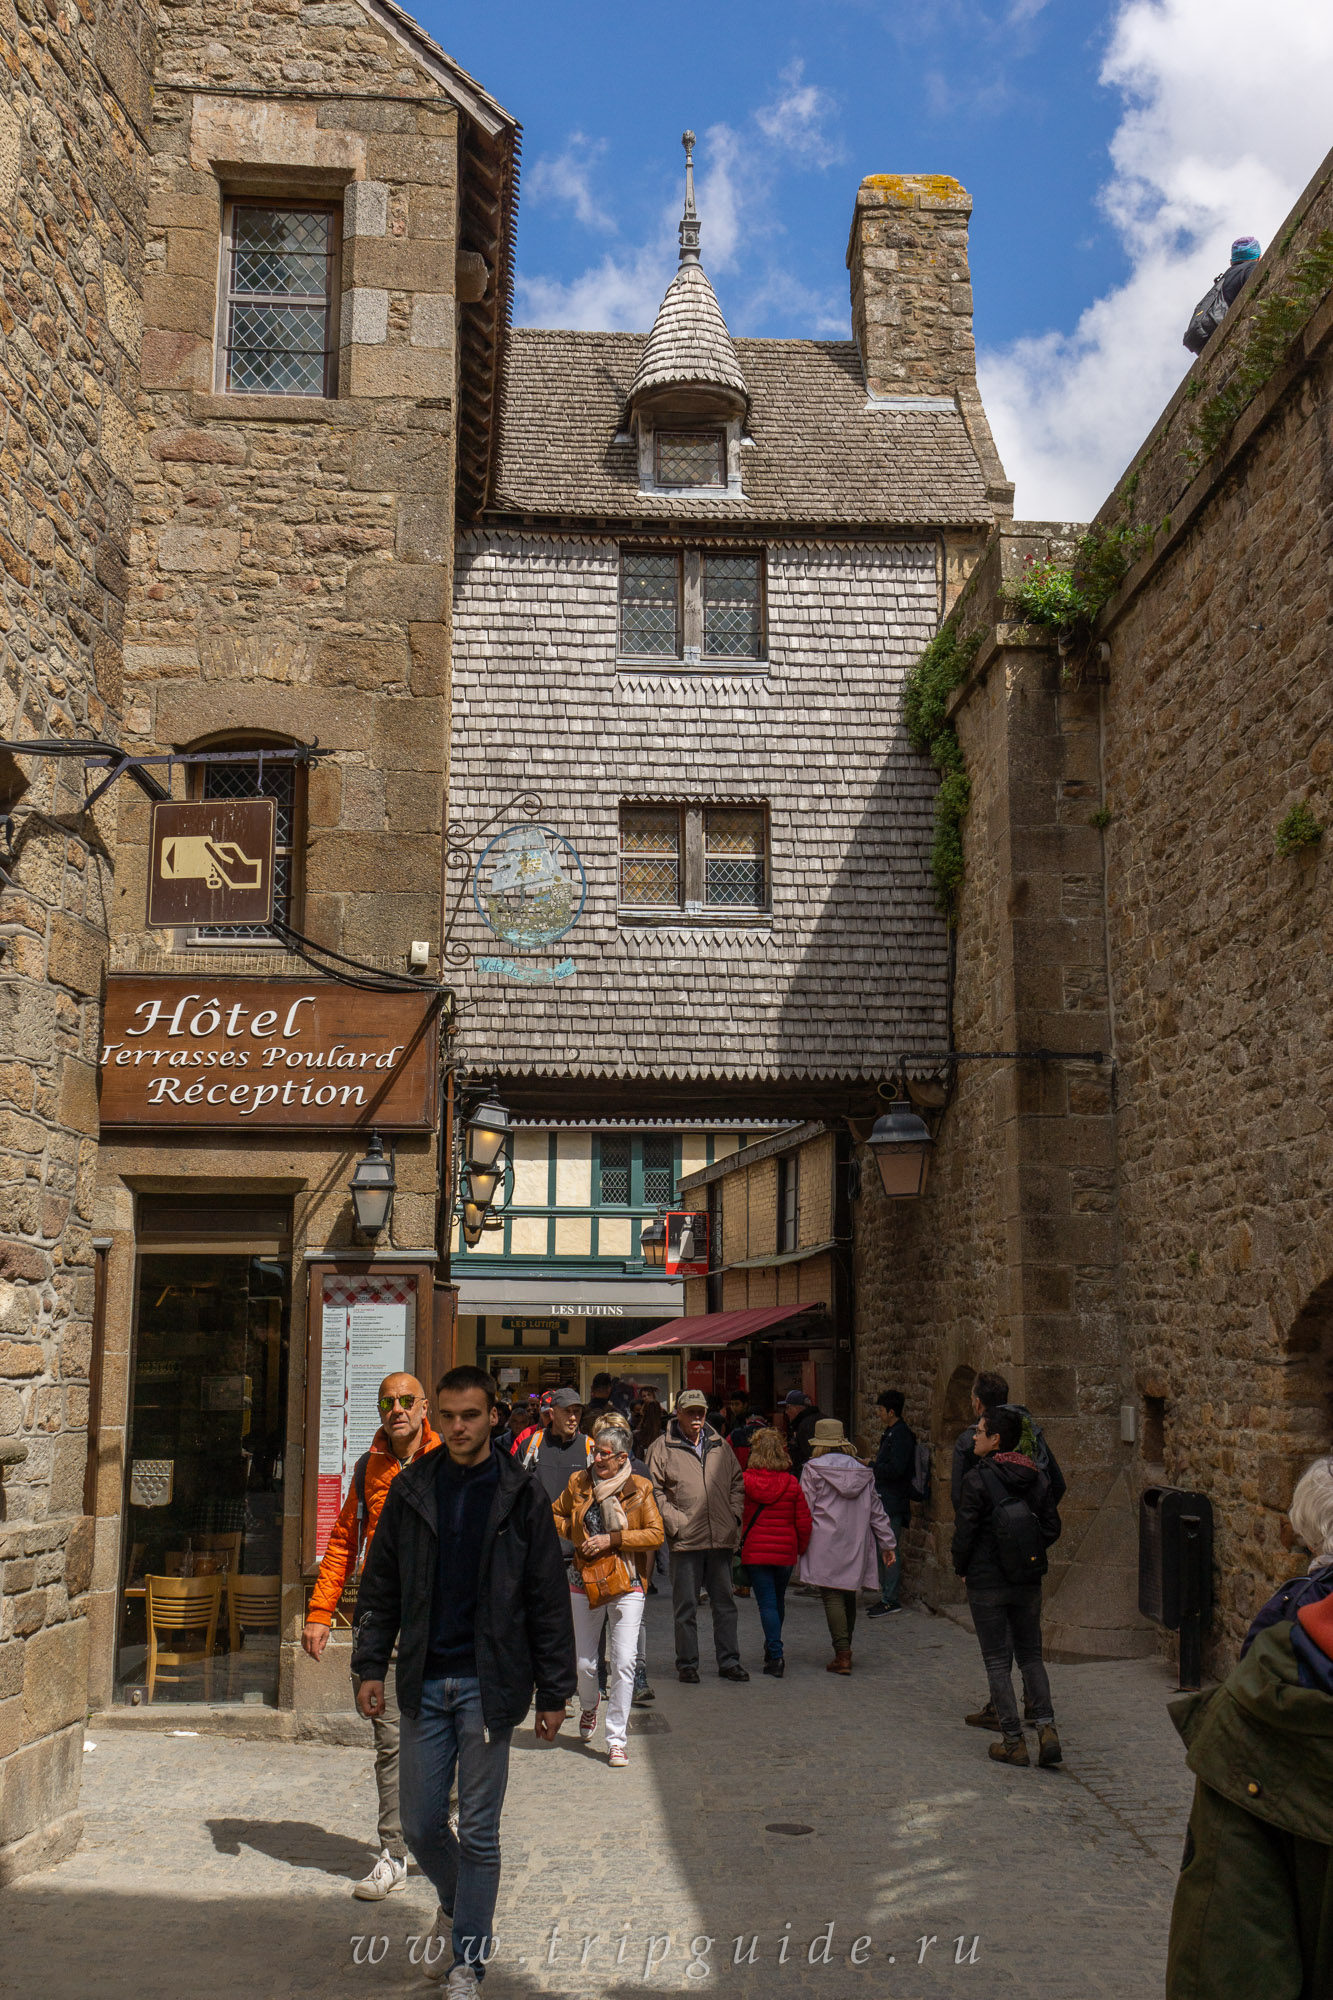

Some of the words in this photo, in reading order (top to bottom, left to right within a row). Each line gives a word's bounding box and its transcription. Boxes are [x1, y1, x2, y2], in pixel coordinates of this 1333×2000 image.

[125, 994, 316, 1037] Hôtel
[98, 1042, 251, 1068] Terrasses
[262, 1044, 405, 1069] Poulard
[147, 1075, 368, 1115] Réception
[510, 1320, 527, 1328] LES
[551, 1305, 575, 1315] LES
[578, 1305, 623, 1316] LUTINS
